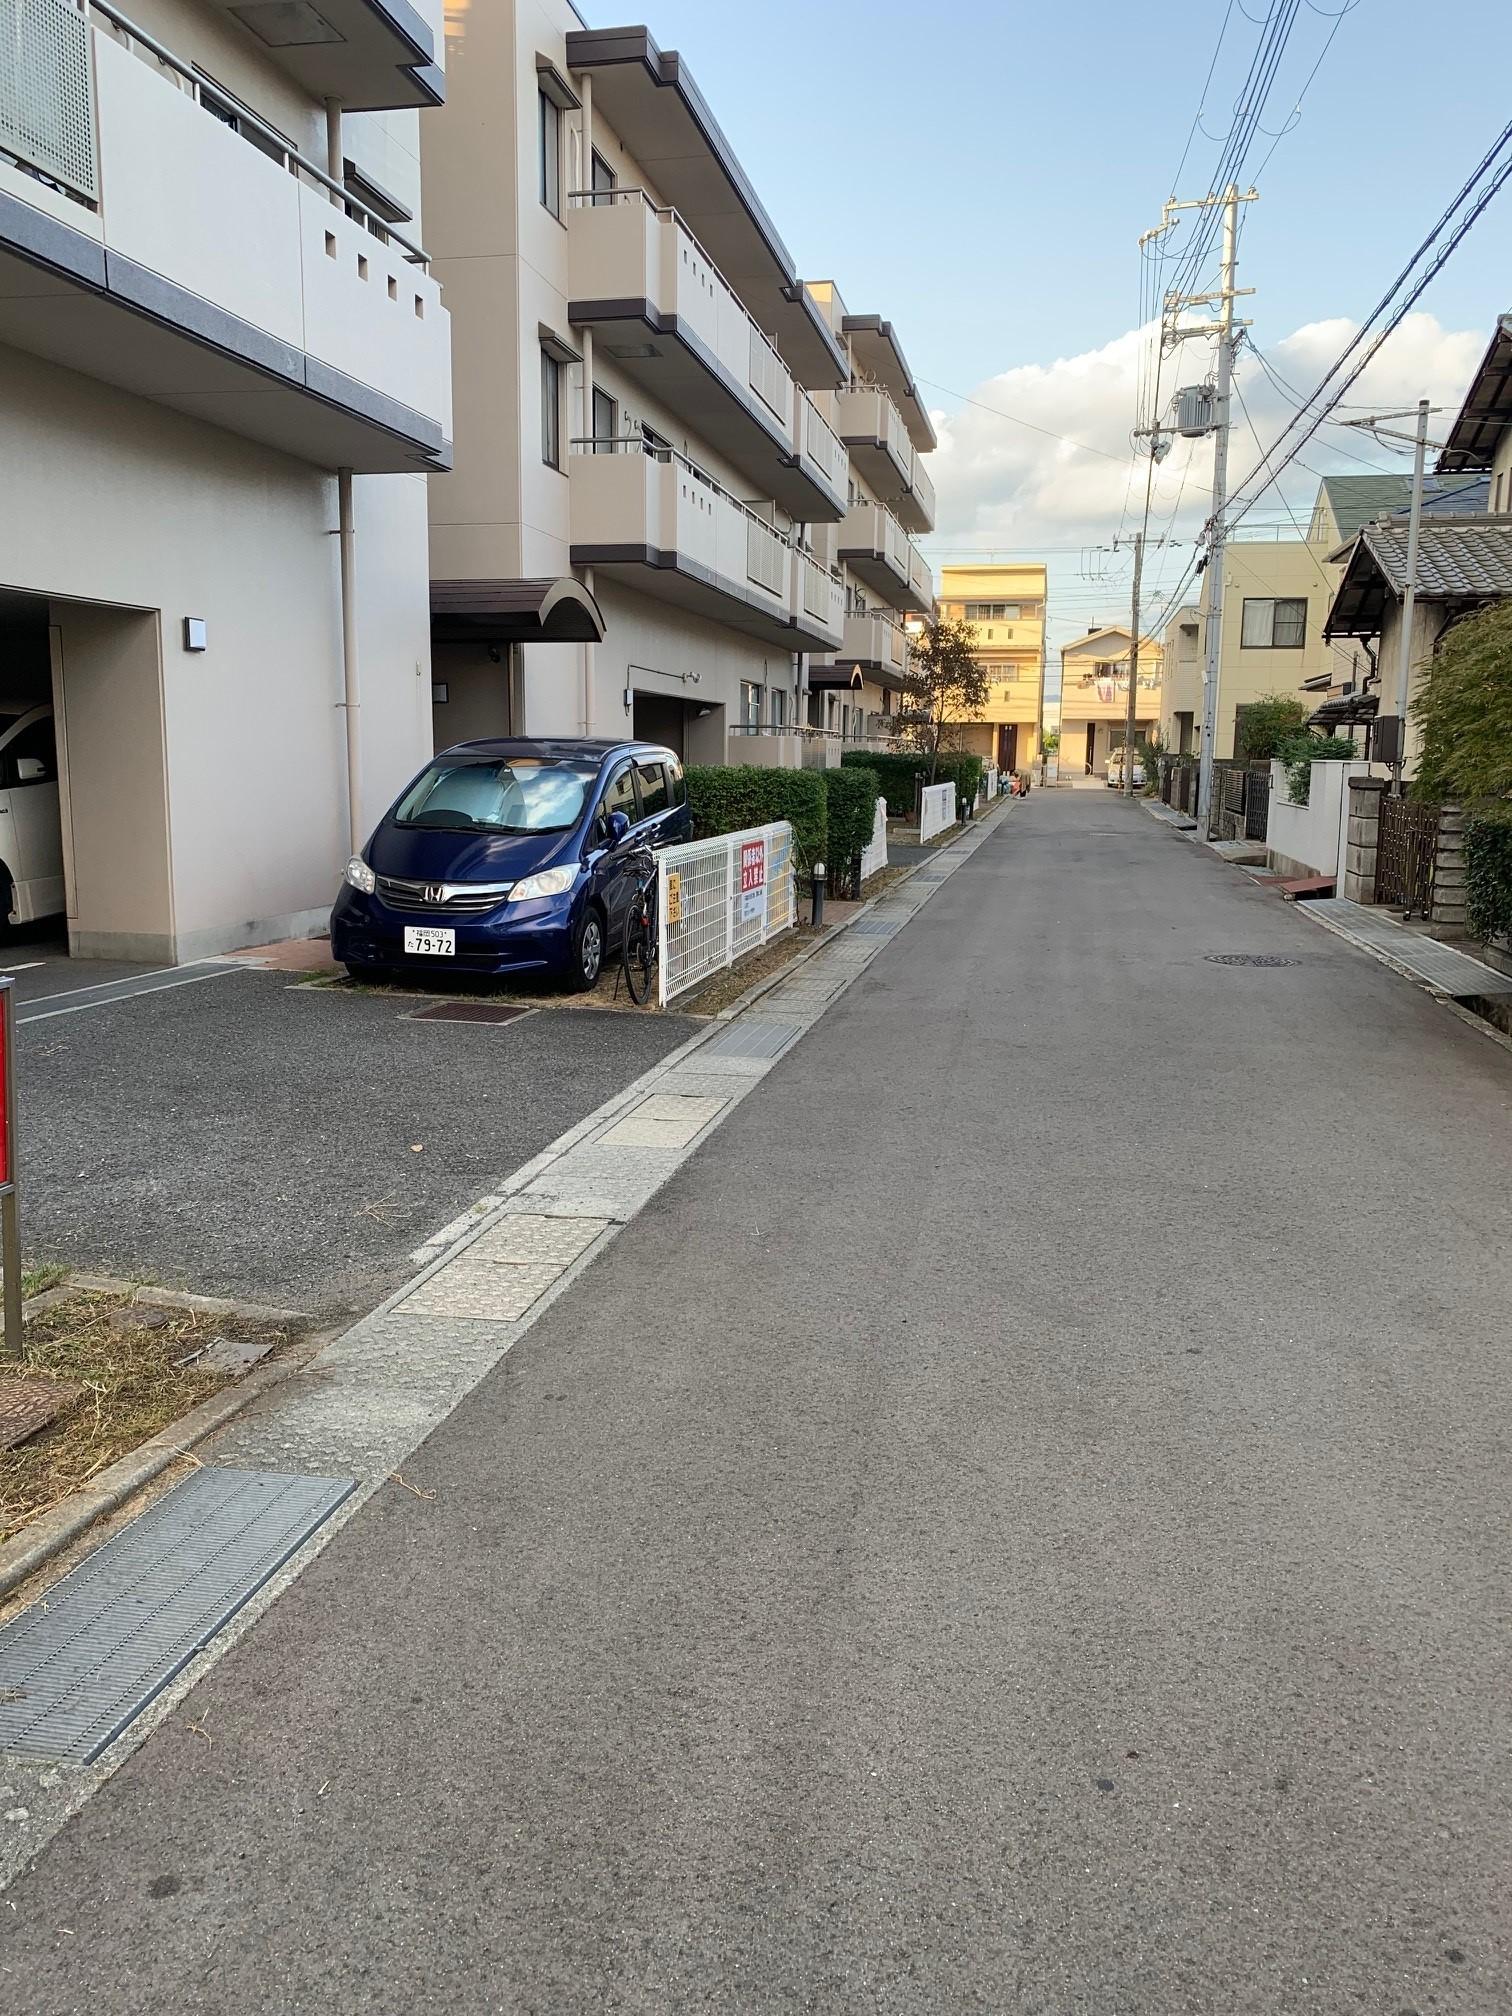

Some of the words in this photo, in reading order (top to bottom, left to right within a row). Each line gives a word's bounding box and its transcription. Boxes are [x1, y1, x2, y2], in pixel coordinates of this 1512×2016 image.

[742, 864, 764, 889] 立入禁止
[415, 938, 452, 953] 79-72
